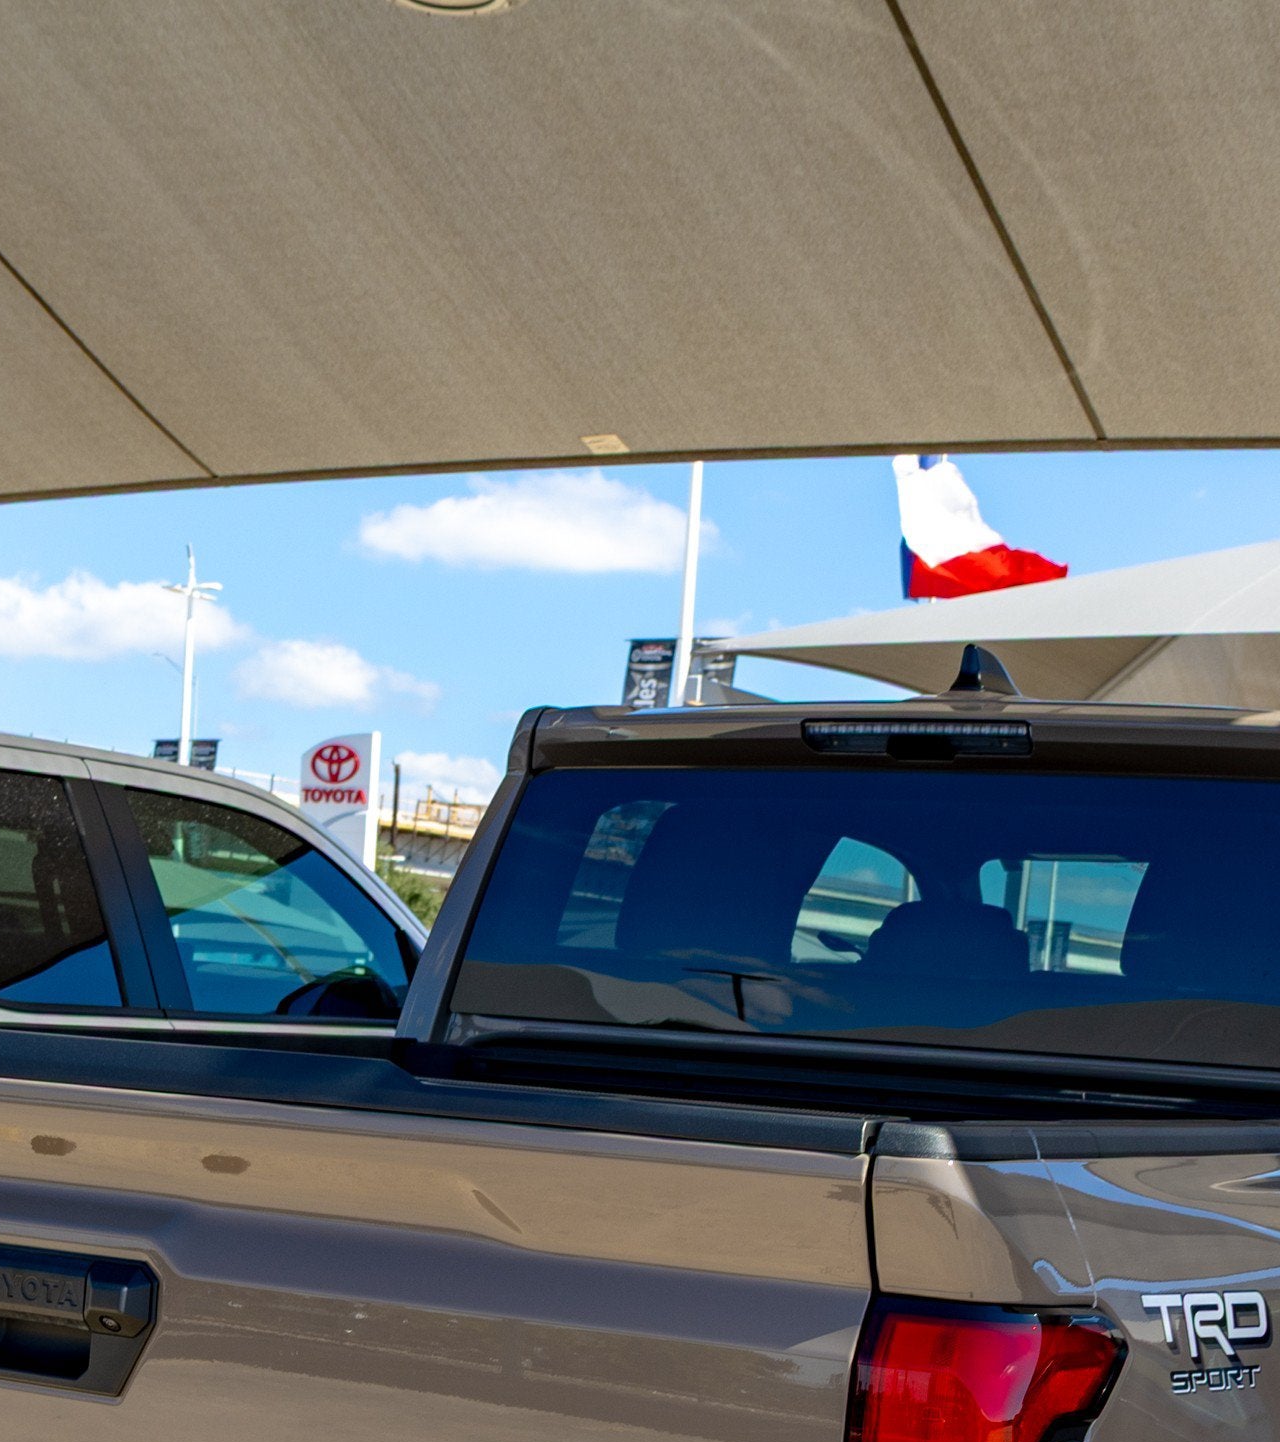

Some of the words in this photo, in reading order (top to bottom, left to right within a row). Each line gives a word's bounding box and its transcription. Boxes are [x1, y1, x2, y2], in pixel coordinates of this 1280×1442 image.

[302, 788, 366, 805] TOYOTA
[1141, 1290, 1270, 1361] TRD
[1170, 1365, 1261, 1394] SPORT
